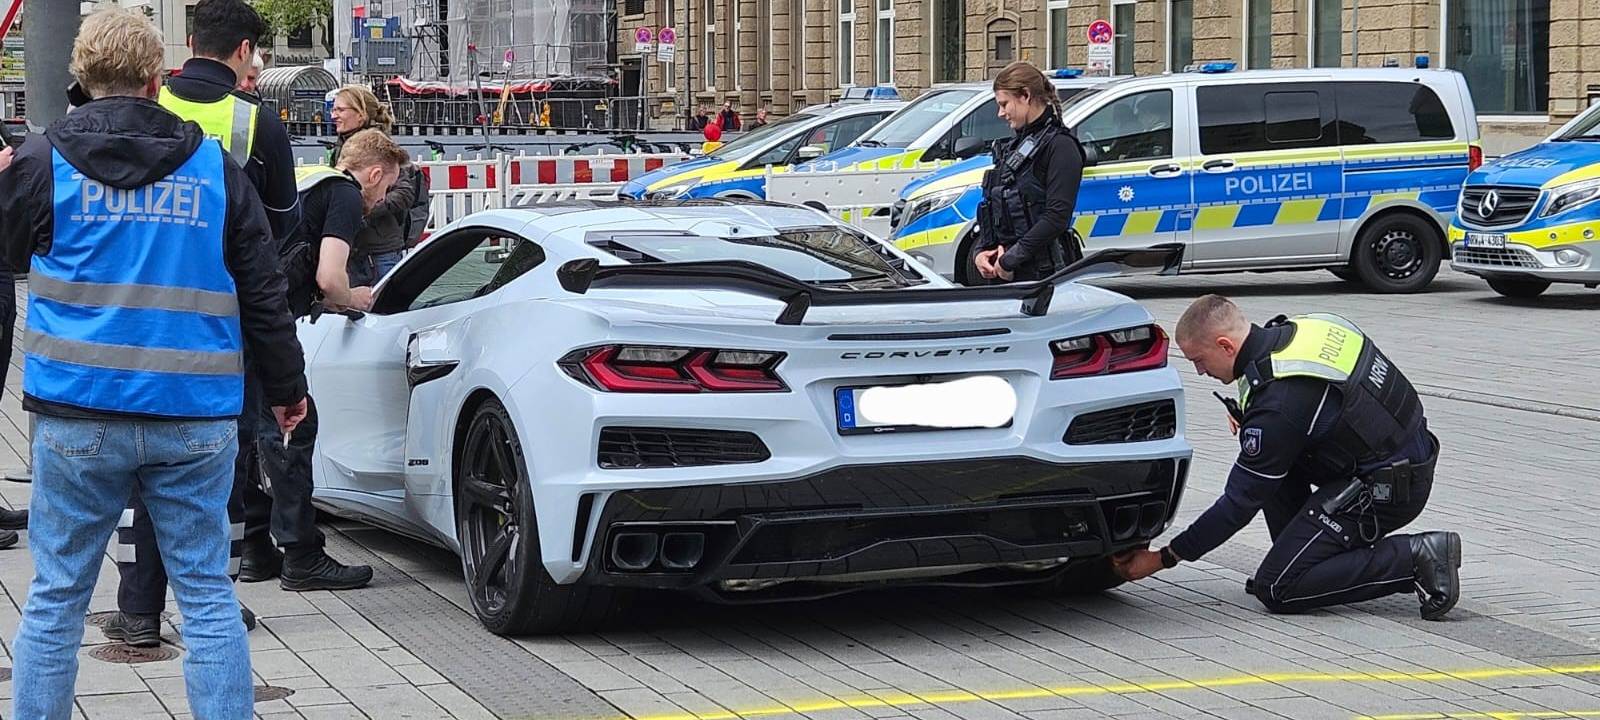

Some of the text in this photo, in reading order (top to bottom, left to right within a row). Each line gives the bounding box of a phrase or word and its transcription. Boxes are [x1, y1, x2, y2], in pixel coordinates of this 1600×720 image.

[82, 179, 201, 218] POLIZEI
[1225, 172, 1313, 196] POLIZEI
[840, 346, 1010, 359] CORVETTE
[1319, 325, 1346, 363] POLIZEI
[1368, 353, 1389, 389] NRW
[1318, 514, 1342, 533] POLIZEI
